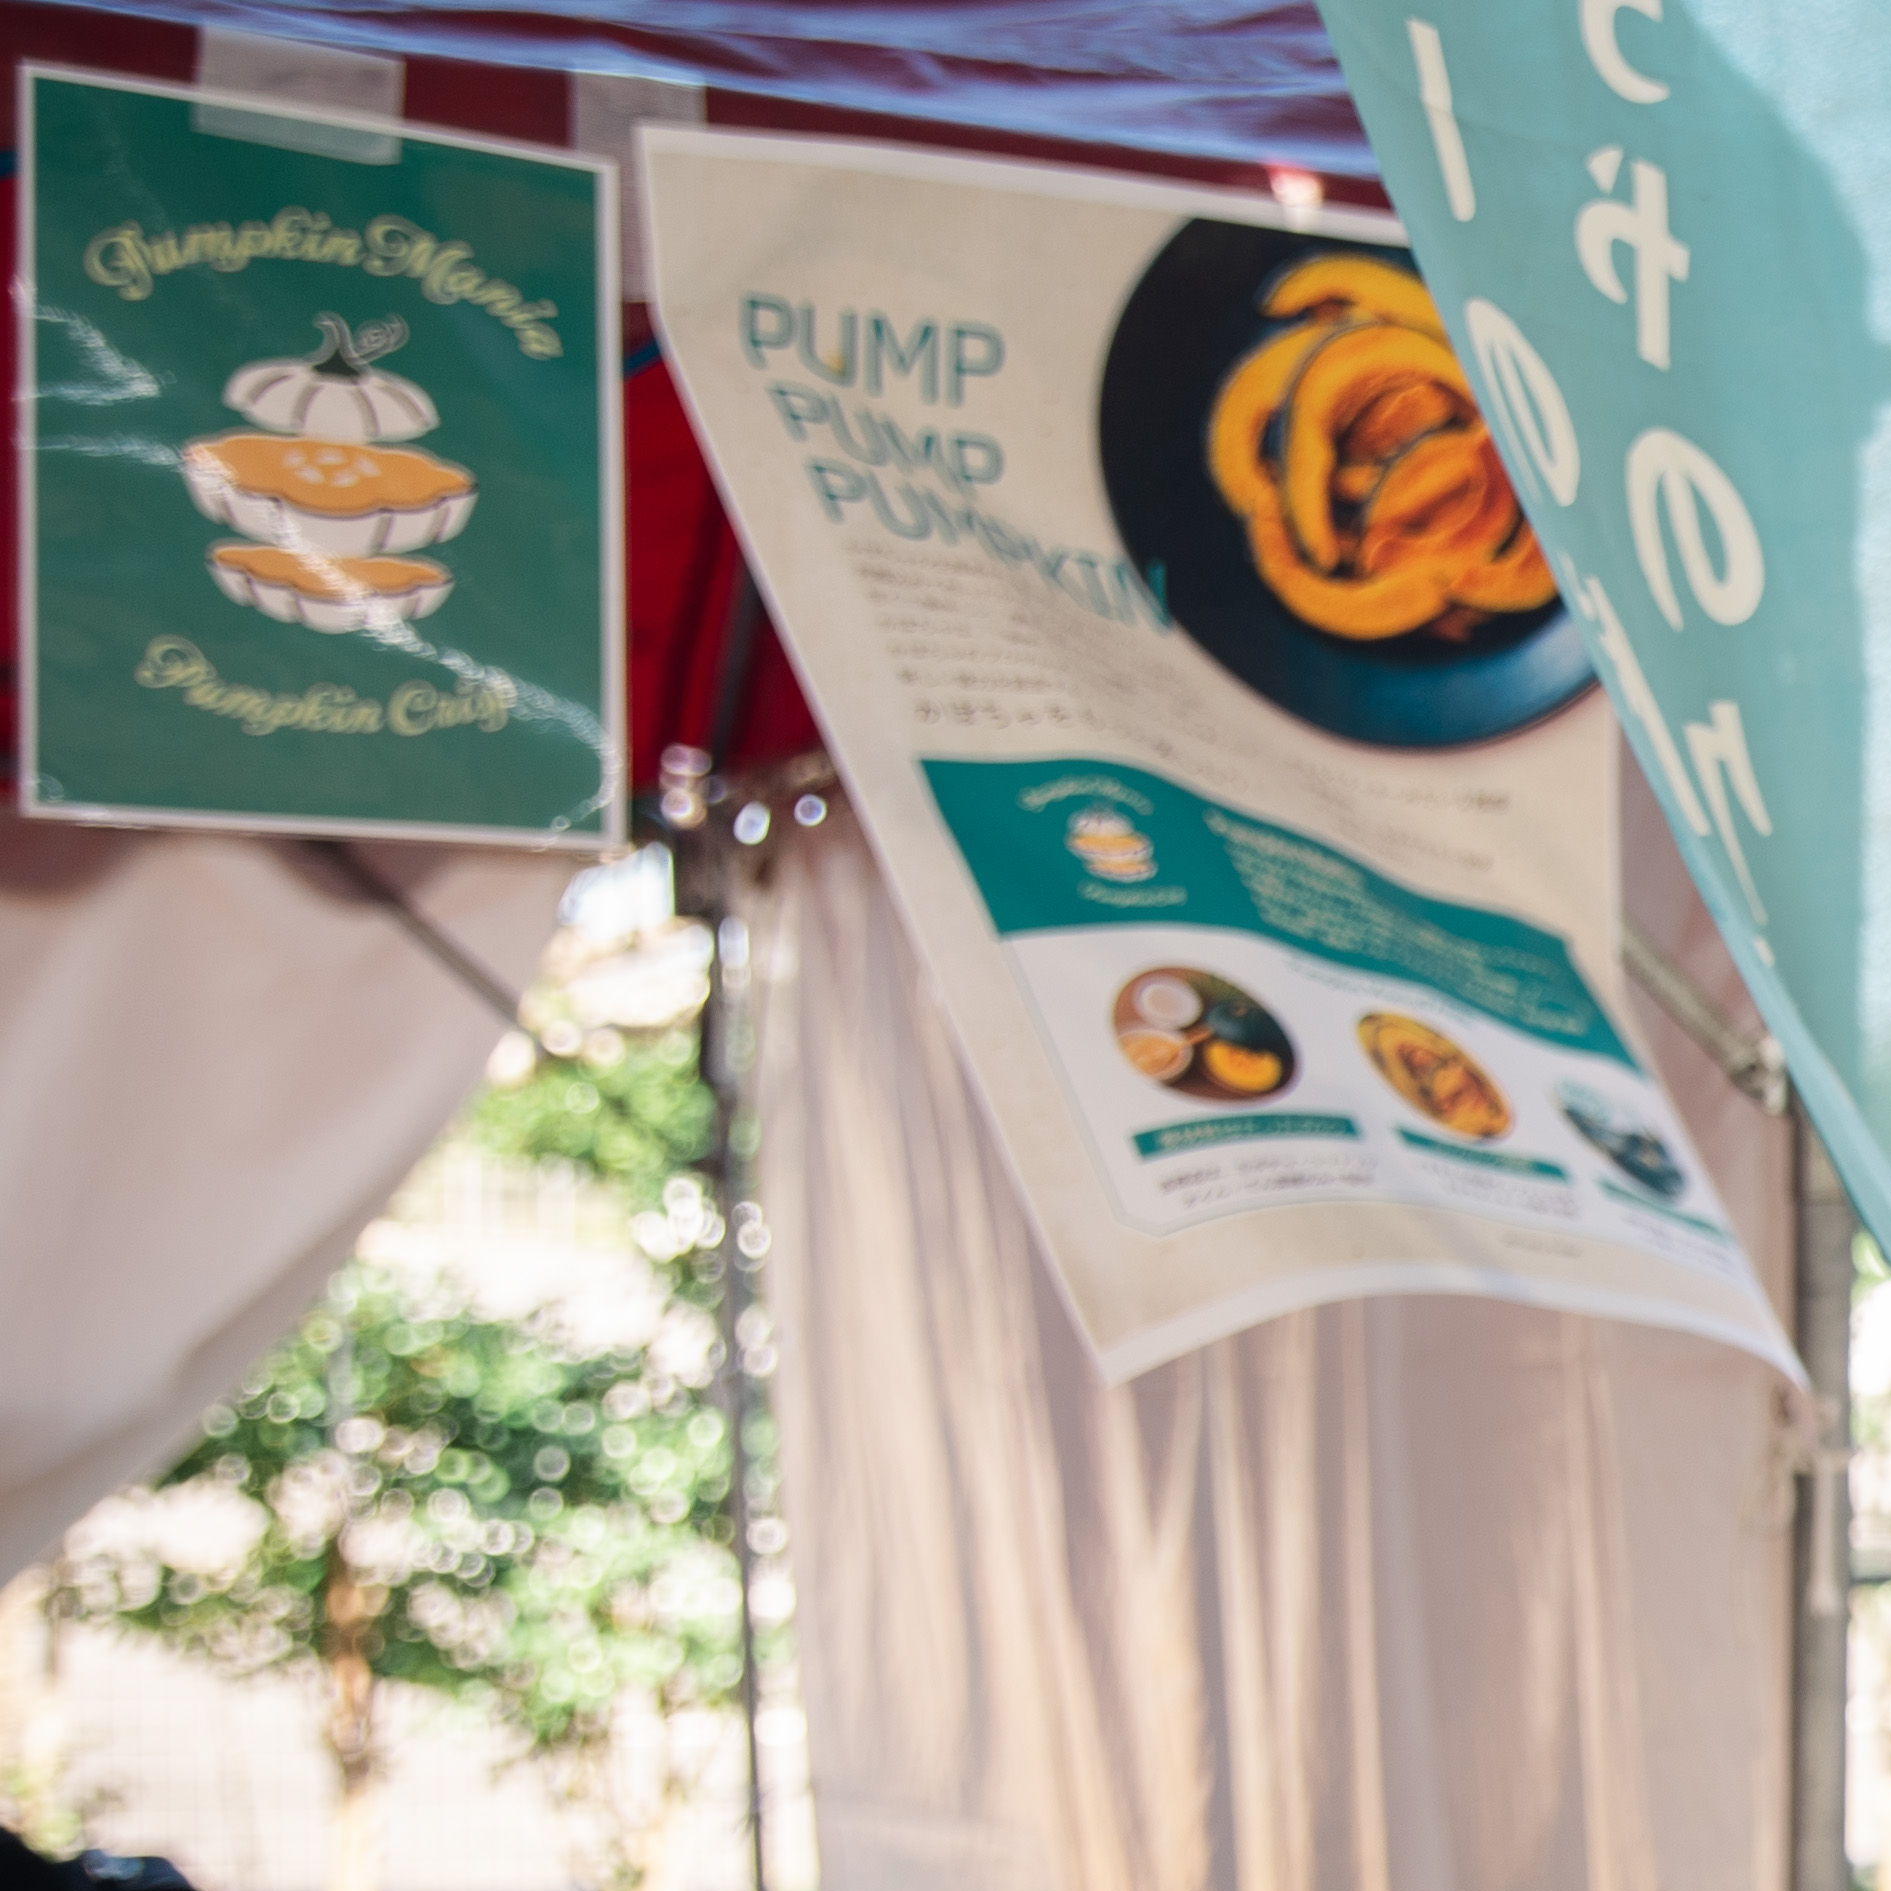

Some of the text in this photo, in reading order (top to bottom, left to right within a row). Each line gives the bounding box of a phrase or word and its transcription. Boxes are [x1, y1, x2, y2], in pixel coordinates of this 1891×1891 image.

[84, 206, 566, 360] Pumpkin Mania
[739, 290, 1006, 409] PUMP
[765, 380, 1006, 492] PUMP
[802, 458, 1171, 636] PUMPKIN
[134, 633, 383, 737] Pumpkin
